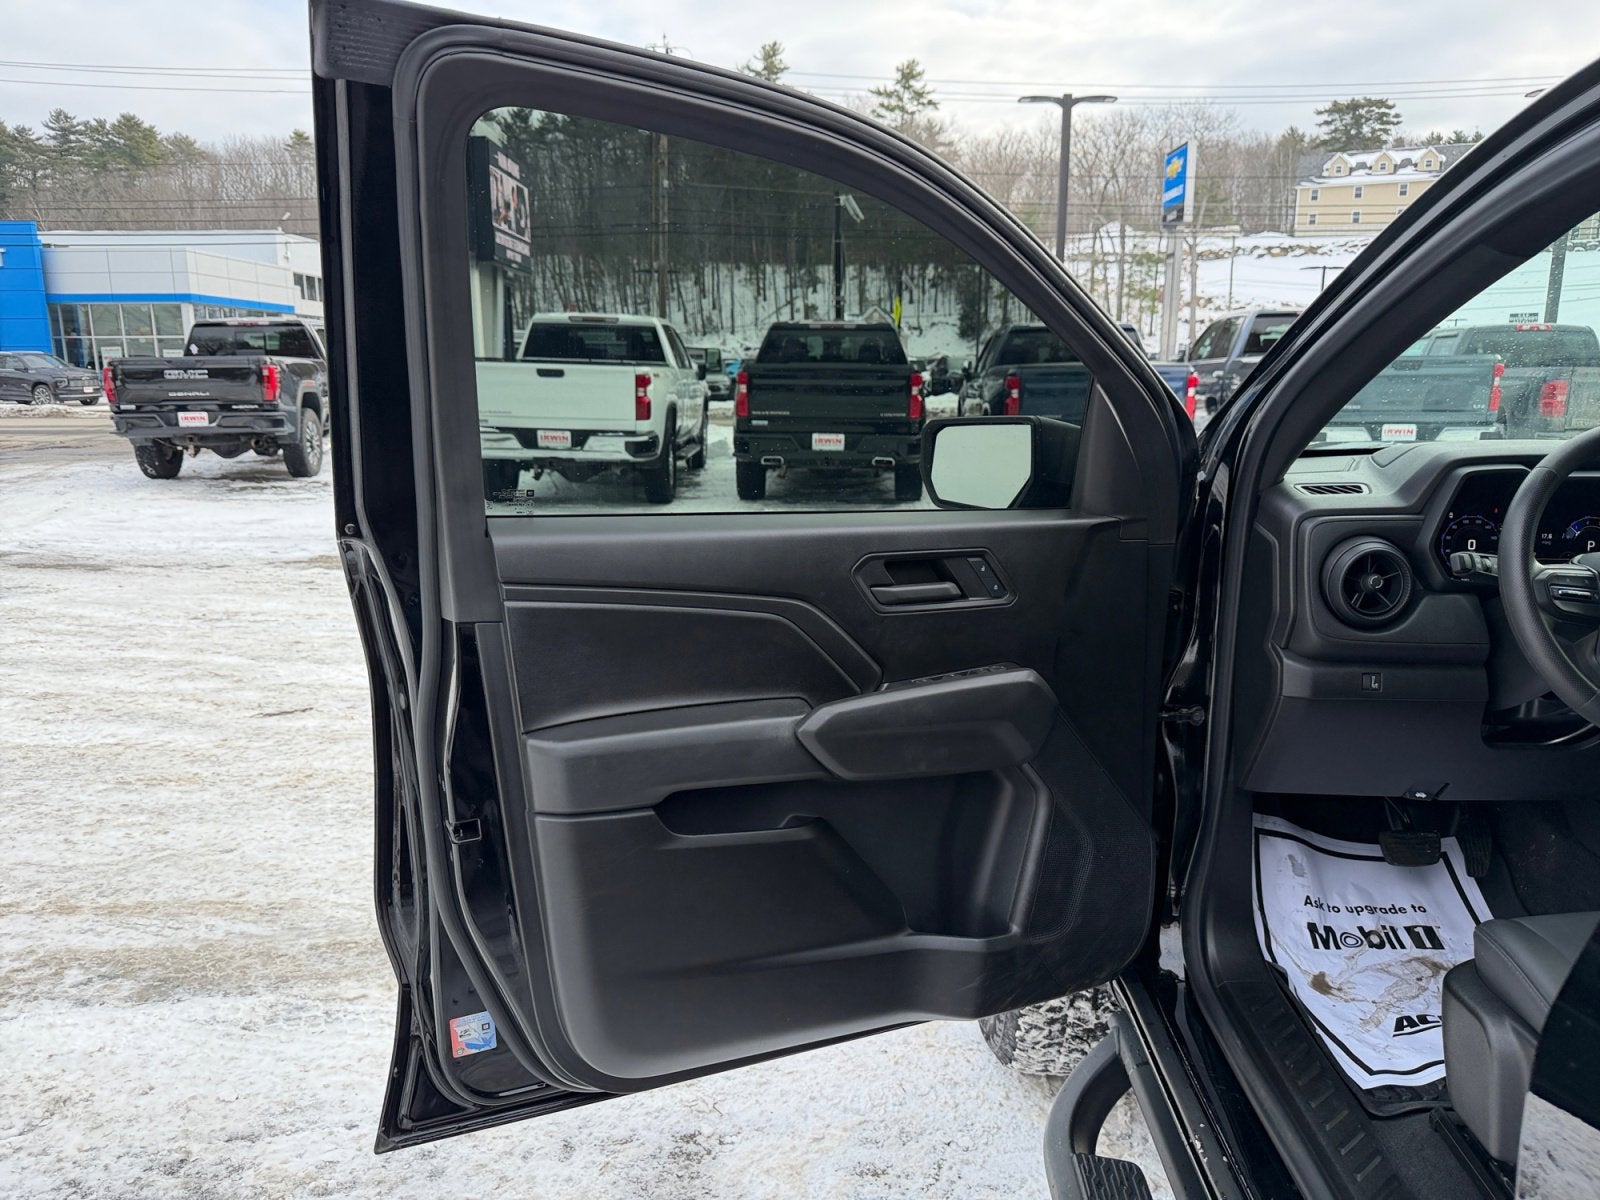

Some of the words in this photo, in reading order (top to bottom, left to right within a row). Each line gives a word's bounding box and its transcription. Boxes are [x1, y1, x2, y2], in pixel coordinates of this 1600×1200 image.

[163, 369, 209, 380] GMC
[1384, 428, 1414, 436] IRWIN
[540, 434, 569, 443] IRWIN
[815, 437, 842, 446] IRWIN
[1587, 540, 1596, 551] P
[1304, 895, 1325, 910] Ask
[1326, 902, 1341, 914] to
[1345, 903, 1408, 916] upgrade
[1411, 903, 1427, 913] to
[1307, 922, 1406, 950] Mobil
[1411, 926, 1436, 949] 1
[1393, 1014, 1443, 1033] AC
